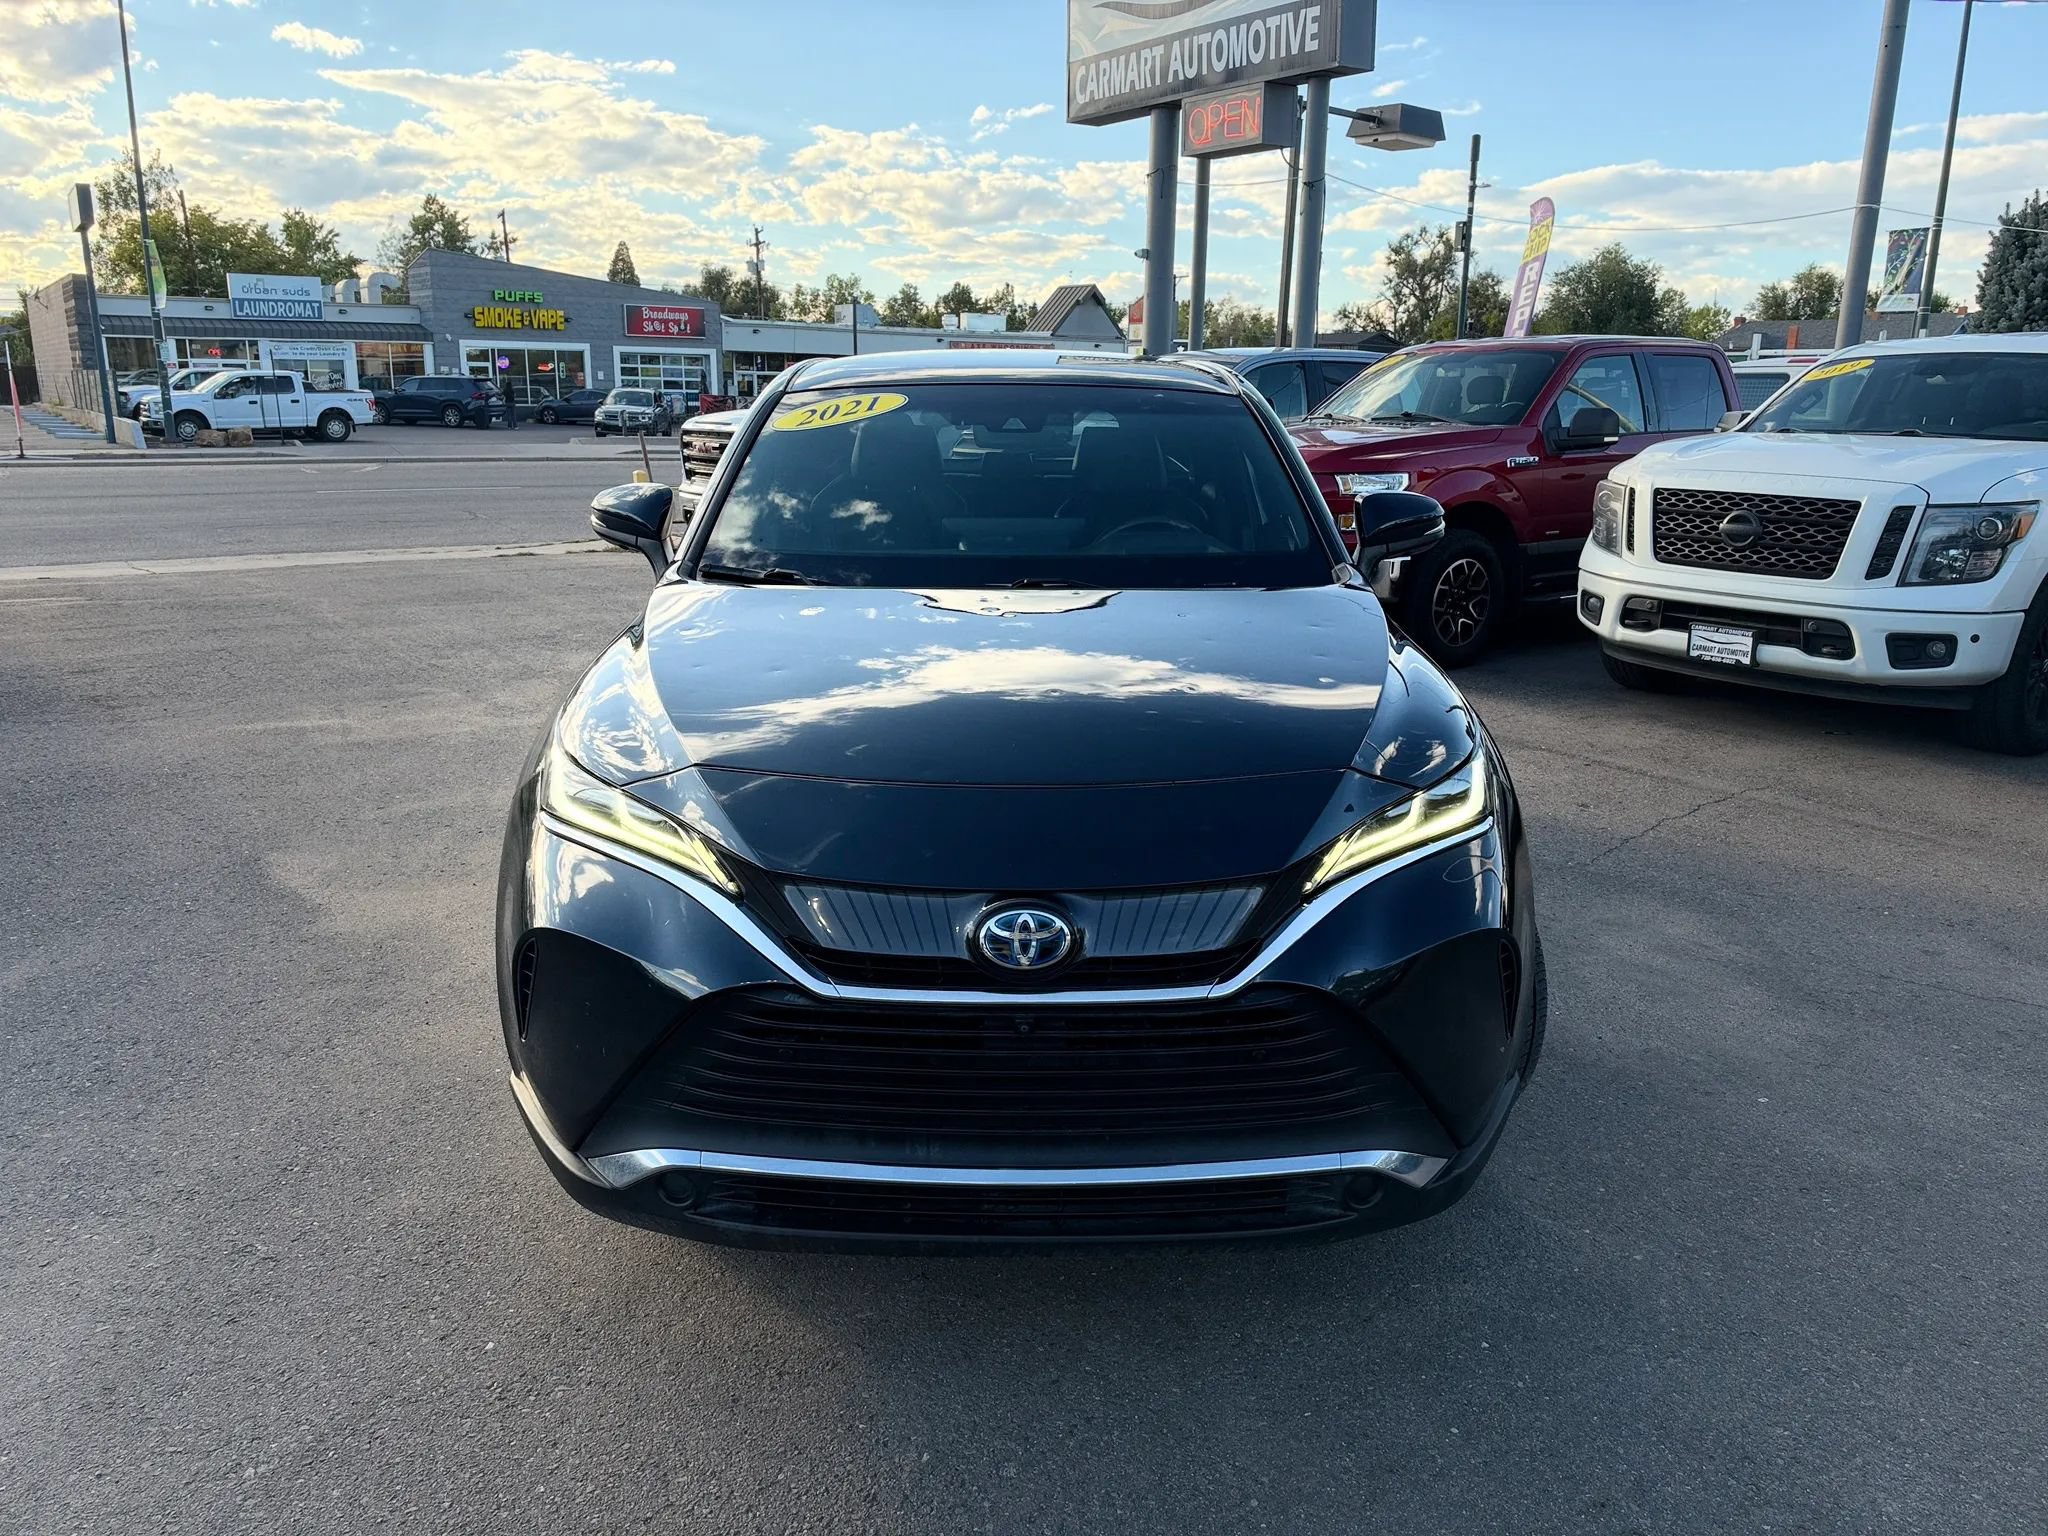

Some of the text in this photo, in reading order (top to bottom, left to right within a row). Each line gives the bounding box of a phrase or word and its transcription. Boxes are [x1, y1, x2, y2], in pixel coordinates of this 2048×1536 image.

[1075, 5, 1322, 104] CARMART AUTOMOTIVE
[1188, 96, 1261, 146] OPEN
[241, 281, 311, 297] urban suds
[494, 289, 544, 303] PUFFS
[234, 299, 320, 318] LAUNDROMAT
[642, 306, 689, 321] Broadways
[474, 306, 565, 330] SMOKE & VAPE
[795, 395, 881, 427] 2021
[1691, 624, 1754, 637] CARMART AUTOMOTIVE
[1691, 643, 1750, 658] CARMART AUTOMOTIVE
